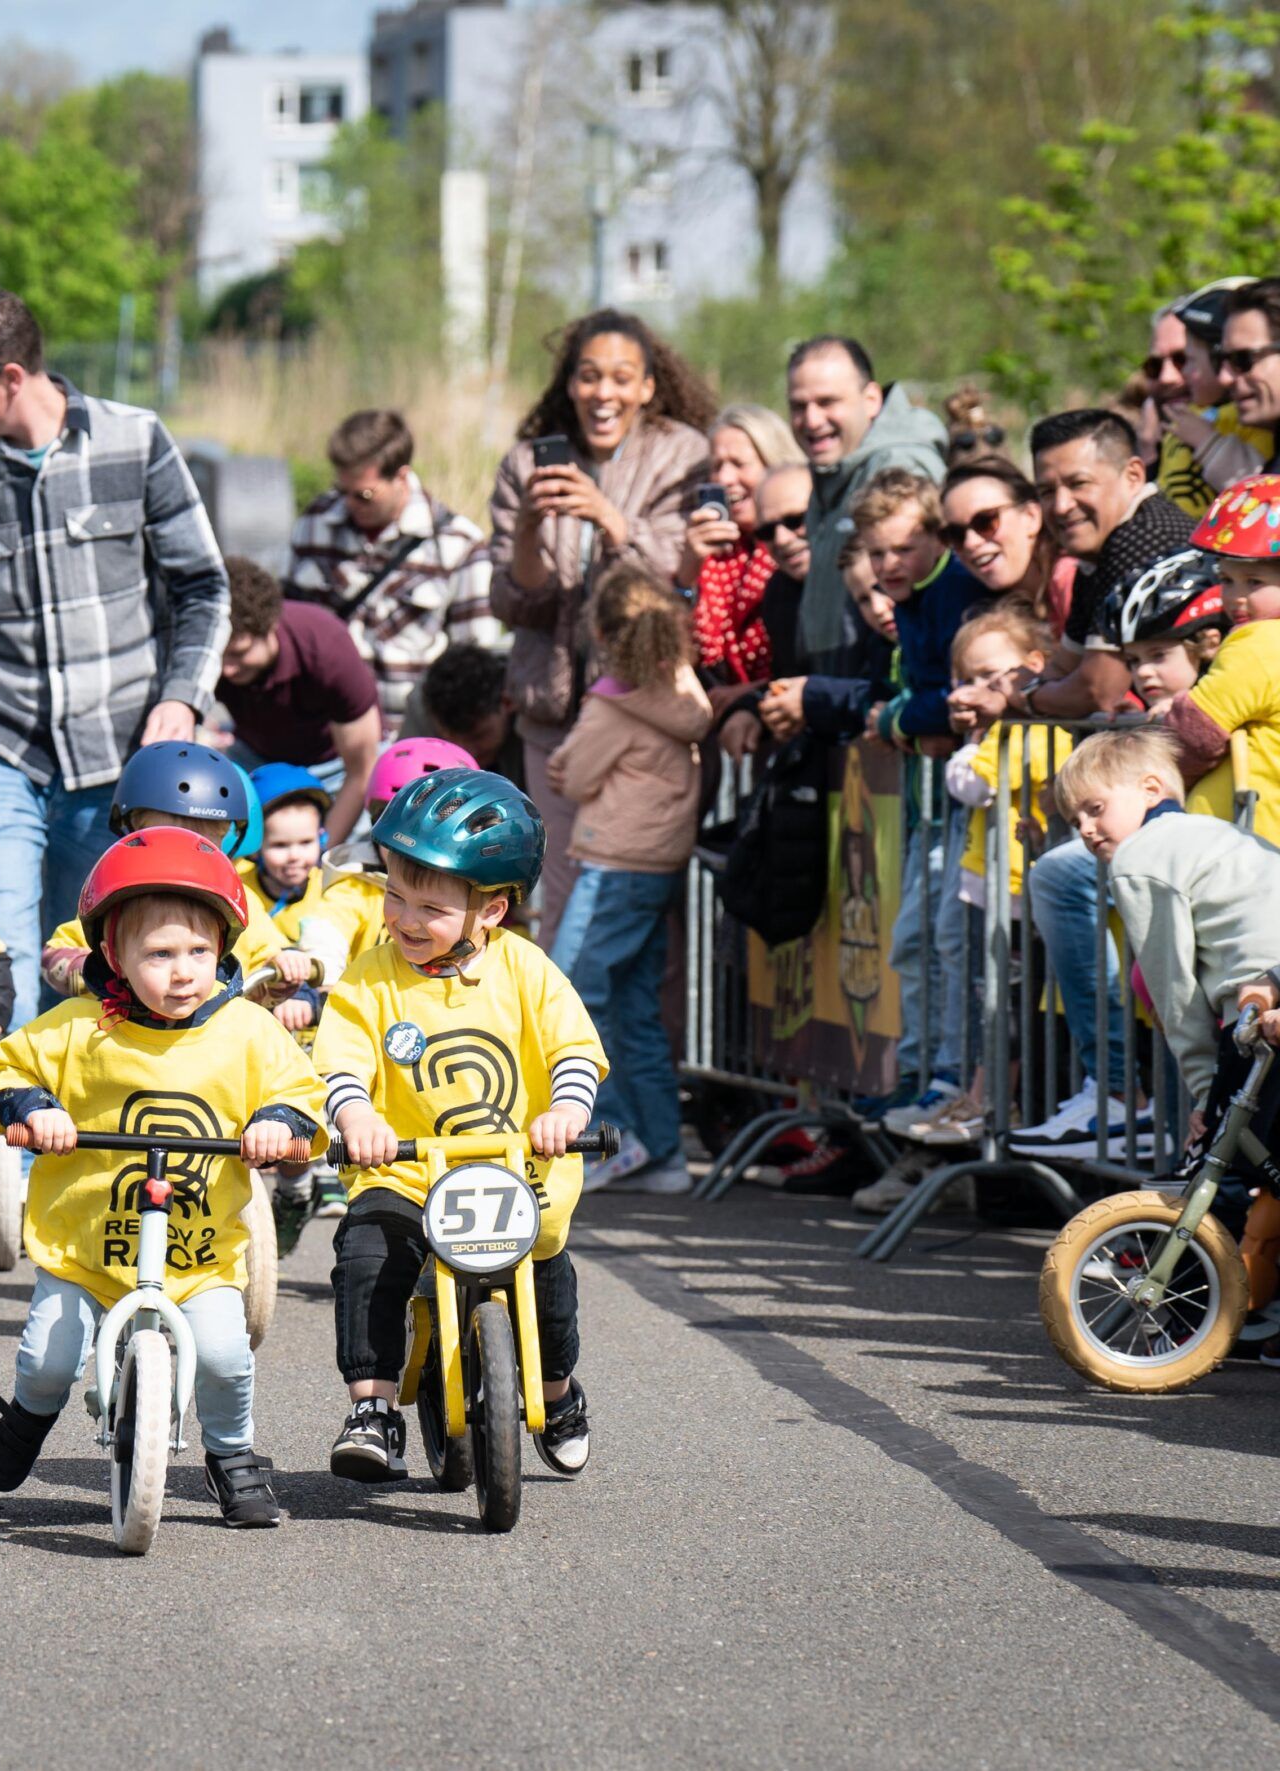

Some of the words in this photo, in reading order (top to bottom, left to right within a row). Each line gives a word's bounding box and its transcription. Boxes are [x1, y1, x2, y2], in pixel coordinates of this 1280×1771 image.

[524, 1160, 539, 1179] 2
[442, 1187, 518, 1235] 57
[105, 1219, 193, 1246] REDY
[201, 1228, 215, 1243] 2
[104, 1239, 219, 1271] RCE
